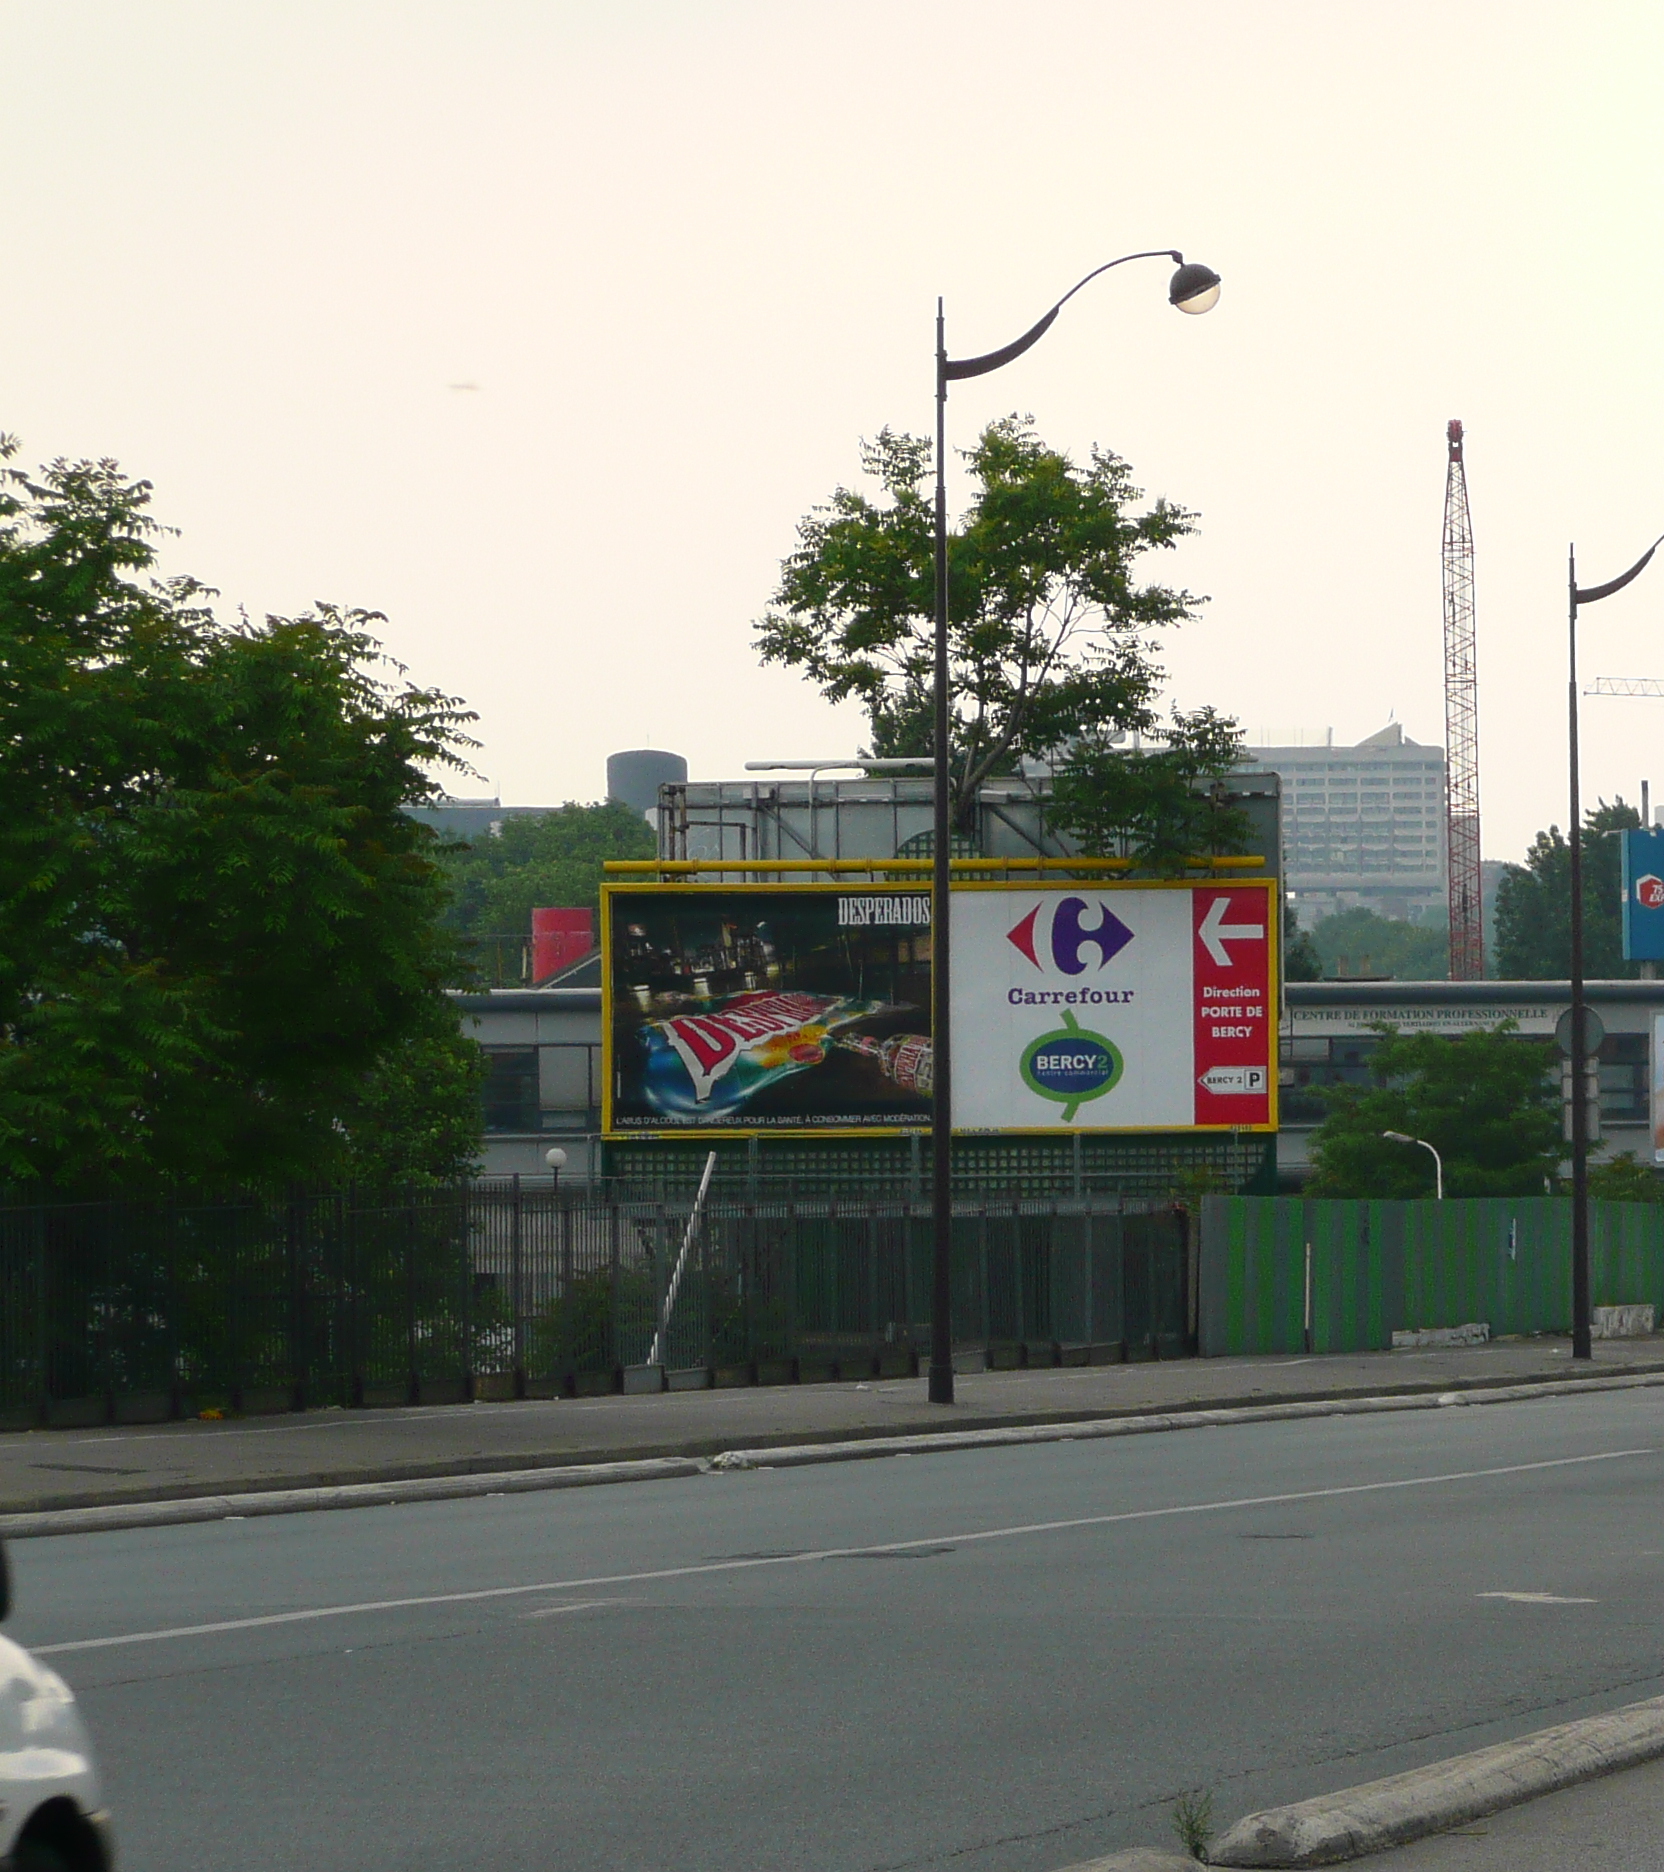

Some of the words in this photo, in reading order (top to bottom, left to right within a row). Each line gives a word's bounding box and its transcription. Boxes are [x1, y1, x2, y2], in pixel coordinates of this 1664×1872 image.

[838, 897, 931, 925] DESPERADOS
[1008, 986, 1135, 1006] Carrefour
[1203, 986, 1261, 998] Direction
[1201, 1006, 1243, 1018] PORTE
[1246, 1006, 1263, 1017] DE
[1294, 1009, 1342, 1020] CENTRE
[1344, 1009, 1360, 1020] DE
[1362, 1008, 1434, 1020] FORMATION
[1437, 1008, 1549, 1019] PROFESSIONNELLE
[1211, 1026, 1253, 1038] BERCY
[1206, 1076, 1234, 1085] BERCY
[1236, 1076, 1243, 1084] 2
[1249, 1072, 1261, 1088] P
[616, 1116, 642, 1125] L'ABUS
[743, 1116, 765, 1125] POUR
[766, 1116, 776, 1124] LA
[812, 1114, 861, 1124] CONSOMMER
[862, 1114, 882, 1123] AVEC
